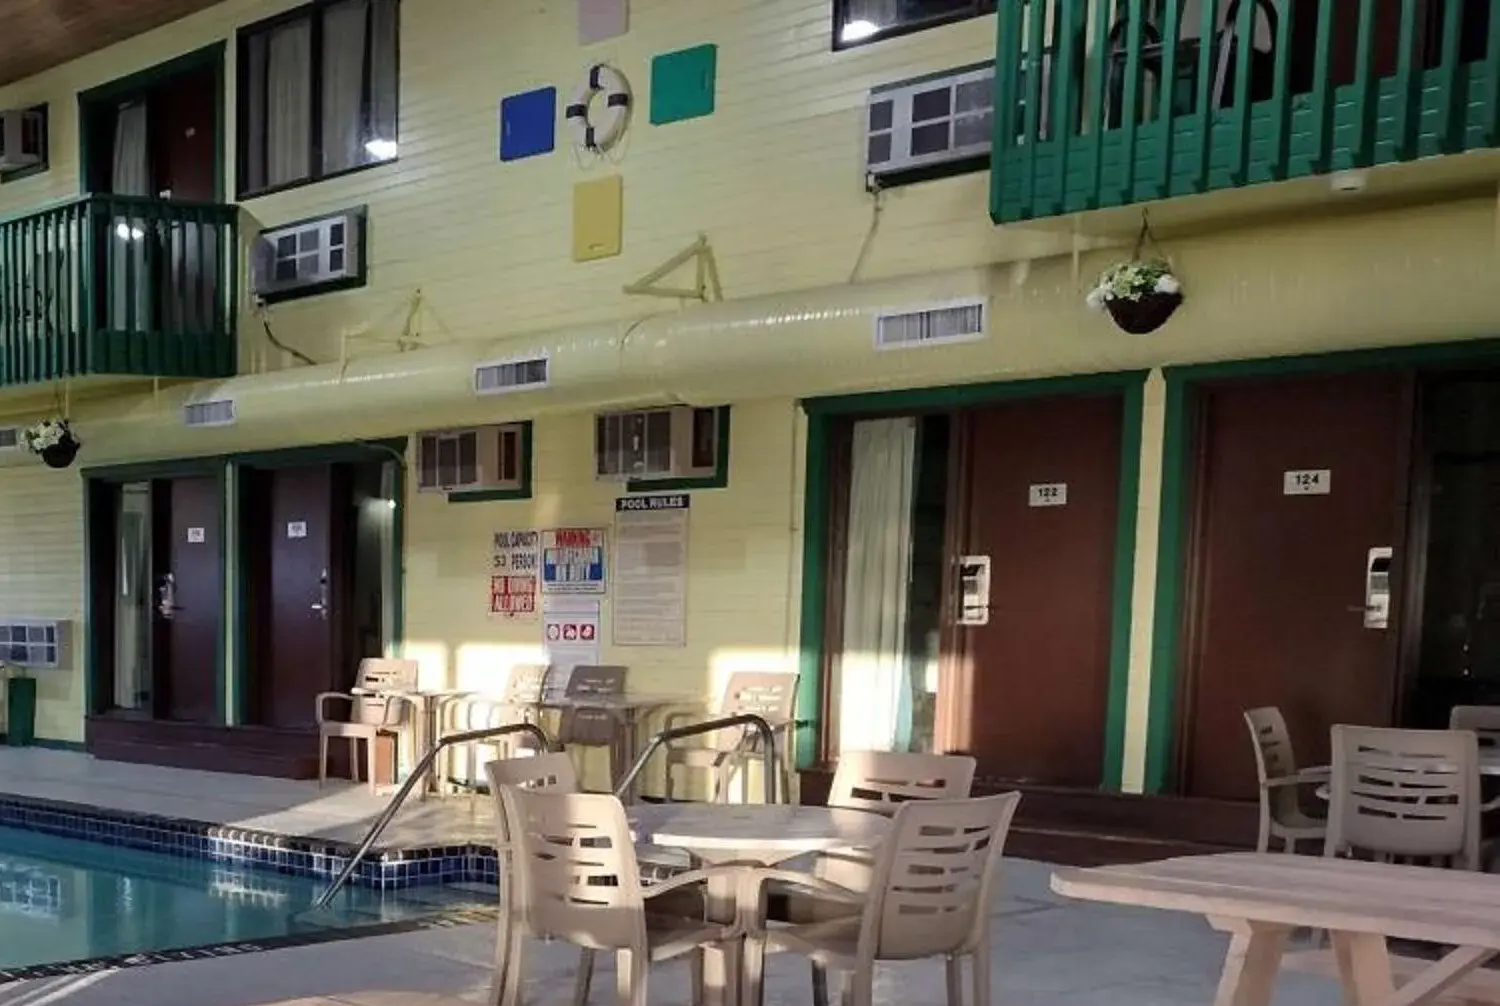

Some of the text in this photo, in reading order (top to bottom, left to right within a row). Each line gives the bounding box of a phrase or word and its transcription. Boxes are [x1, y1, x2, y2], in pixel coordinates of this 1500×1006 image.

[1296, 473, 1319, 485] 124
[1038, 487, 1058, 497] 122
[621, 496, 684, 510] POOL RULES
